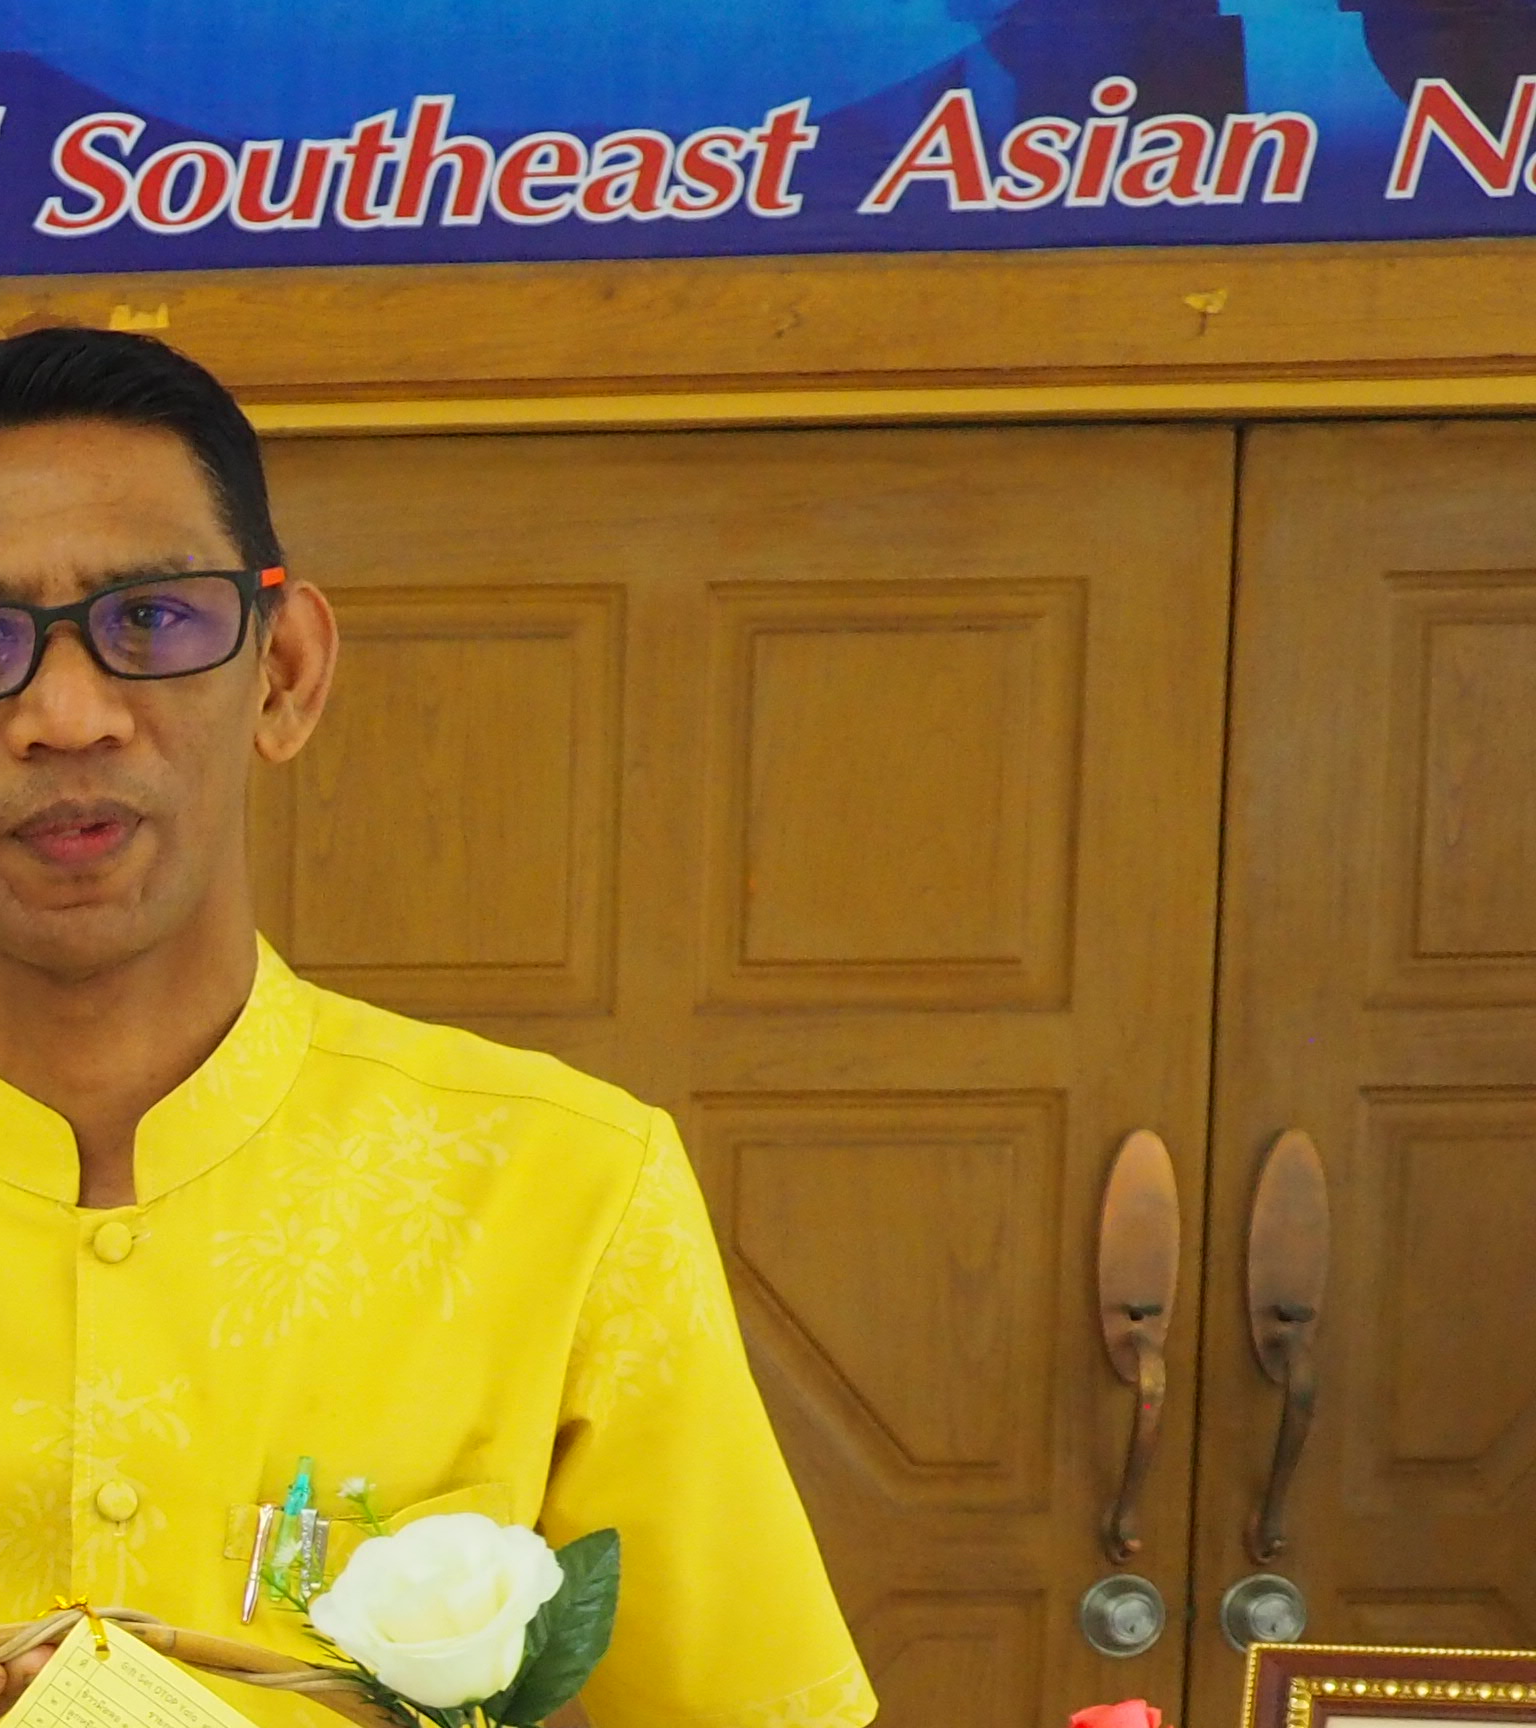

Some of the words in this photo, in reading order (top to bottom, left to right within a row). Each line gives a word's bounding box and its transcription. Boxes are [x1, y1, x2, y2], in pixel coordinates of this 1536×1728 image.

[36, 94, 817, 236] Southeast
[858, 75, 1317, 215] Asian
[1385, 74, 1536, 199] N
